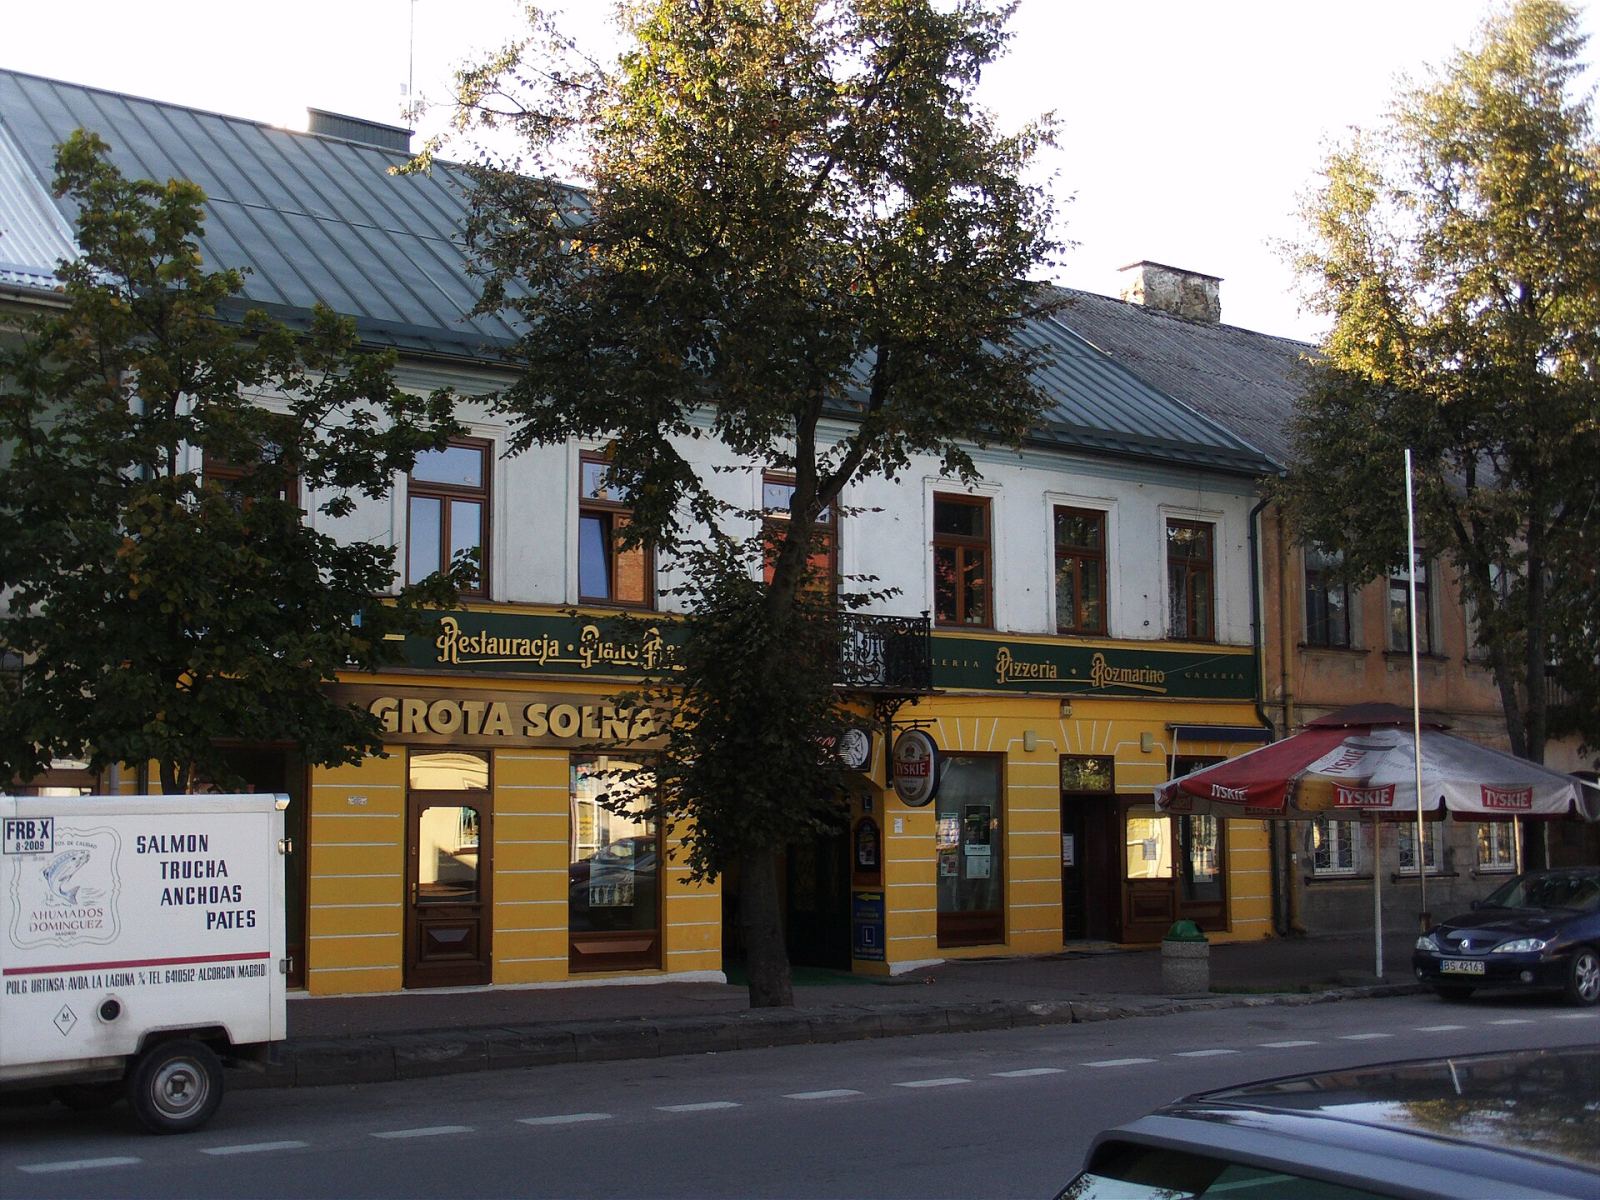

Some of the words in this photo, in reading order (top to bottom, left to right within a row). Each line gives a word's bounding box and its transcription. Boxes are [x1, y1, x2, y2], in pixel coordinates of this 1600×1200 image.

[436, 616, 560, 666] Restauracja
[995, 646, 1057, 684] Pizzeria
[1090, 652, 1165, 688] Rozmarino
[1184, 671, 1245, 680] GALERIA
[369, 697, 514, 737] GROTA
[526, 703, 657, 740] SOLNA
[896, 762, 926, 776] TYSKIE
[1319, 749, 1367, 774] TYSKIE
[1211, 784, 1249, 801] TYSKIE
[1337, 788, 1390, 804] TYSKIE
[1484, 789, 1529, 807] TYSKIE
[136, 834, 209, 854] SALMON
[160, 860, 228, 880] TRUCHA
[160, 885, 242, 906] ANCHOAS
[32, 908, 103, 920] AHUMADOS
[207, 910, 256, 930] PATES
[29, 919, 103, 932] DOMINGUEZ
[105, 972, 135, 988] LAGUNA
